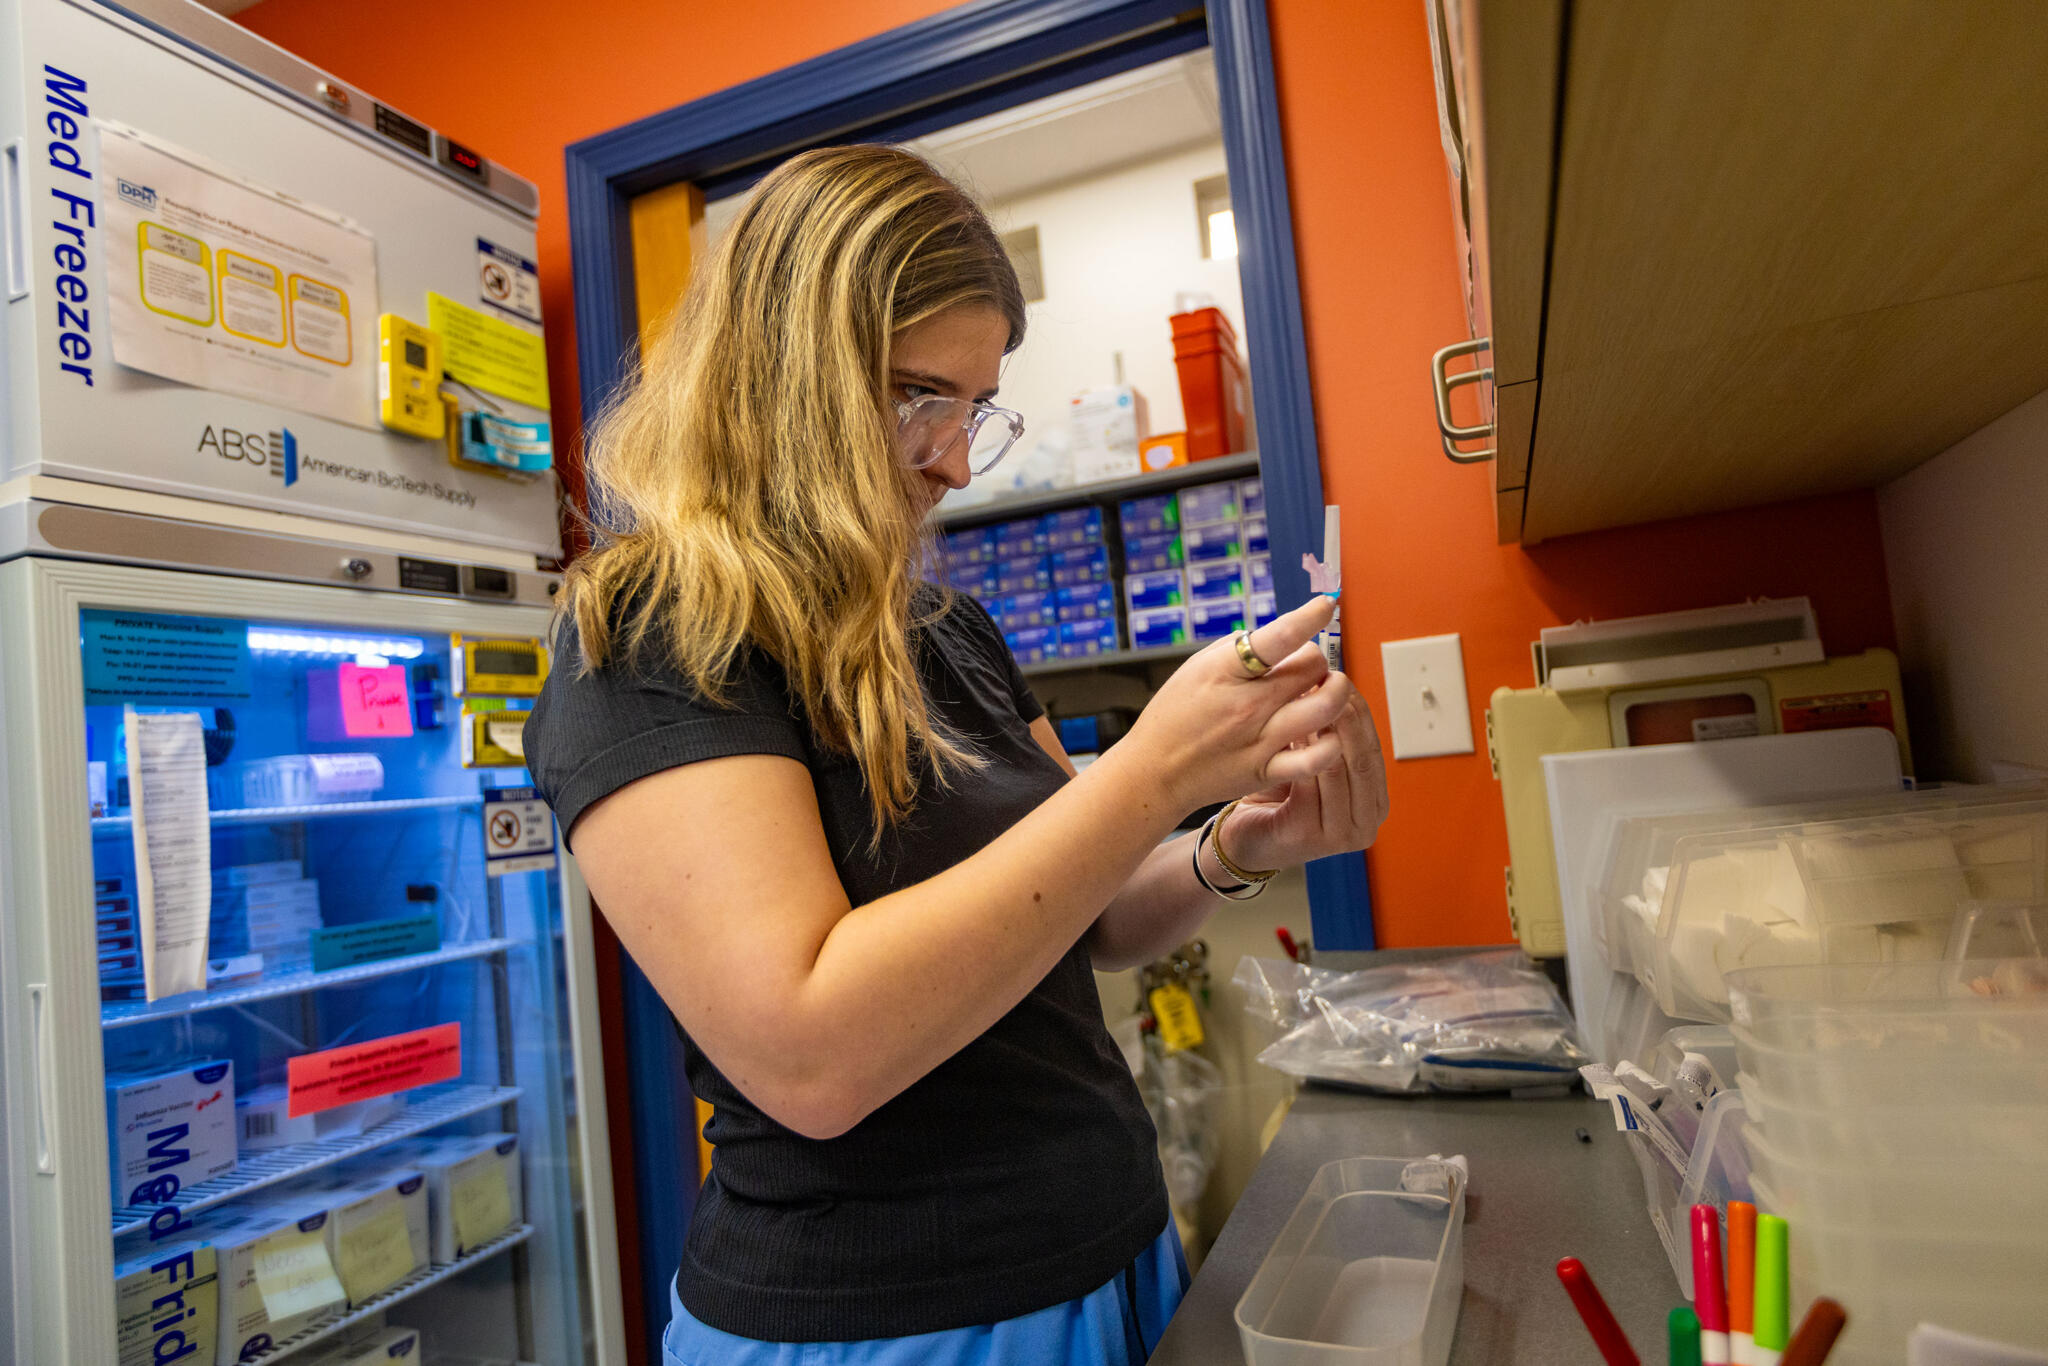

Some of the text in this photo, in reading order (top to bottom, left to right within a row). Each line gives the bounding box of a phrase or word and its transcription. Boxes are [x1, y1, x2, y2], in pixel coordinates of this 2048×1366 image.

[120, 183, 153, 204] DPH
[44, 64, 96, 388] Med Freezer
[198, 424, 266, 466] ABS
[301, 455, 477, 508] American BioTech Supply
[115, 618, 224, 635] PRIVATE Vaccine Supply
[136, 1101, 194, 1121] Influenza Vaccine
[147, 1122, 197, 1366] Med Frid
